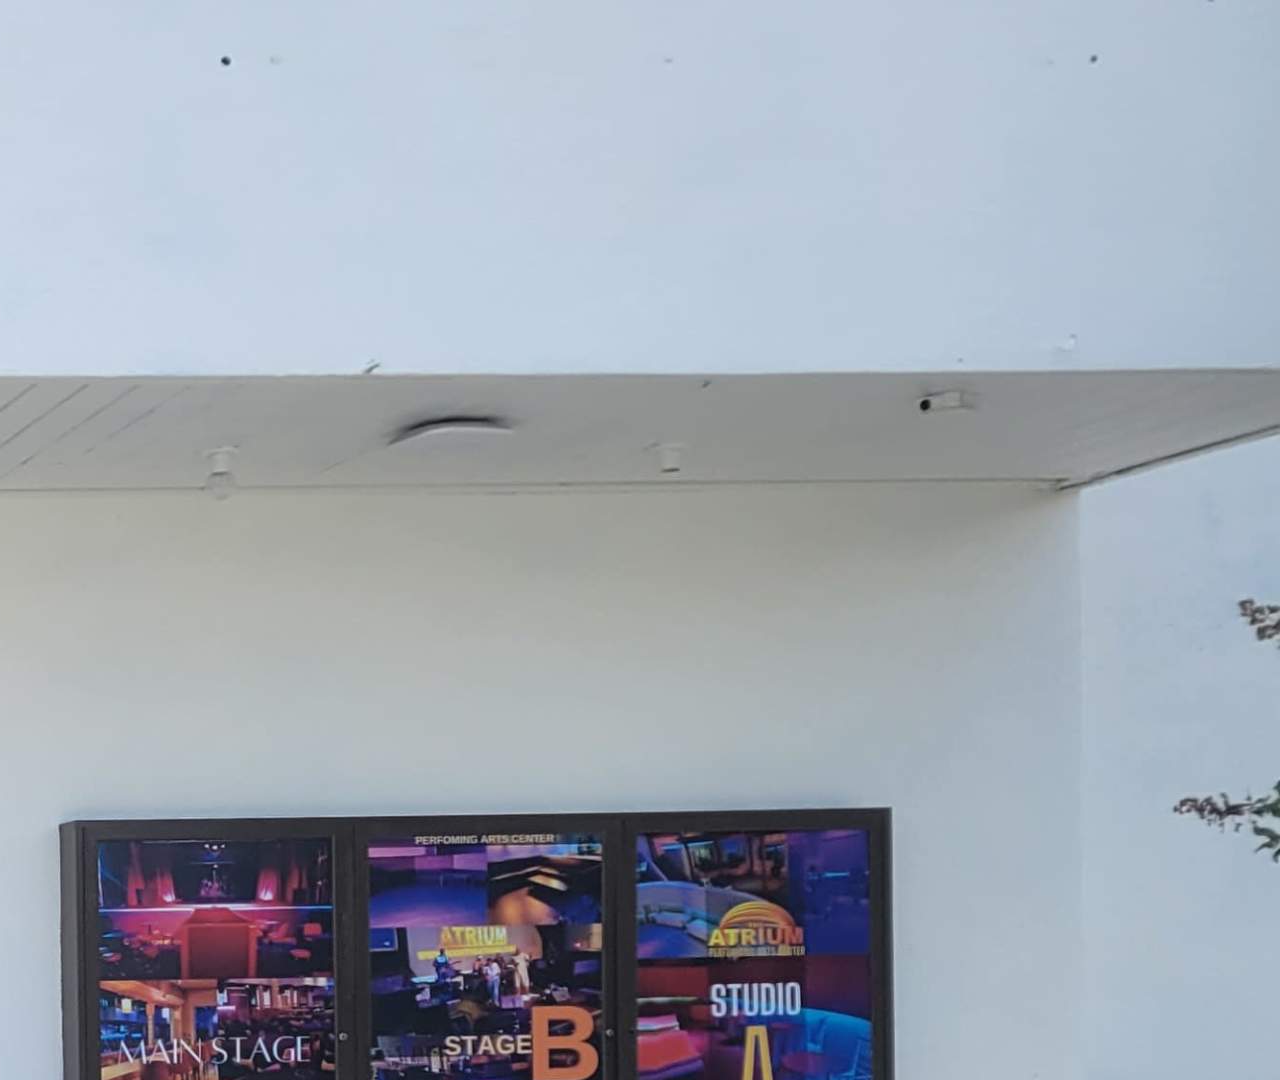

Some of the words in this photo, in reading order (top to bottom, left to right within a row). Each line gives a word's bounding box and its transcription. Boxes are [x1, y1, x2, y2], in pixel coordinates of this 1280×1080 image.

[480, 834, 508, 844] ARTS
[511, 833, 555, 843] CENTER
[441, 926, 508, 945] ATRIUM
[708, 926, 804, 946] ATRIUM
[710, 982, 801, 1018] STUDIO
[117, 1037, 203, 1065] MAIN
[211, 1035, 311, 1065] STAGE
[444, 1034, 532, 1056] STAGE
